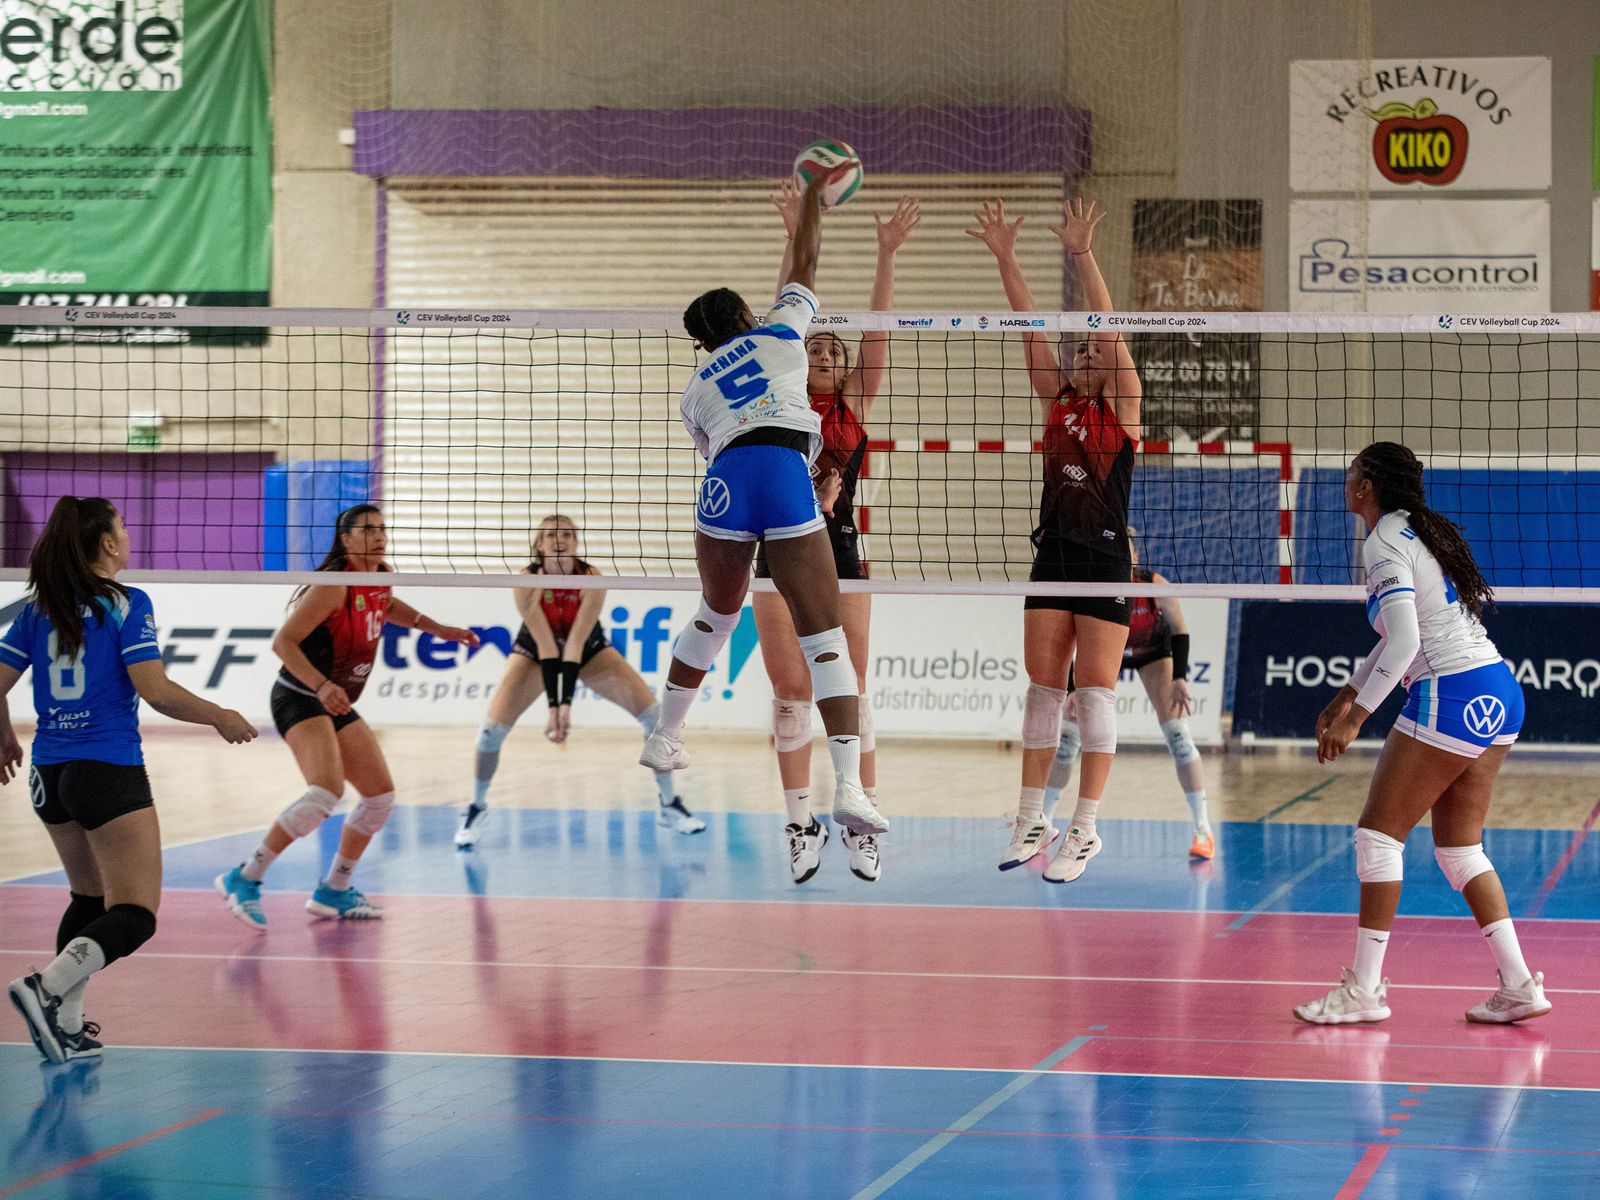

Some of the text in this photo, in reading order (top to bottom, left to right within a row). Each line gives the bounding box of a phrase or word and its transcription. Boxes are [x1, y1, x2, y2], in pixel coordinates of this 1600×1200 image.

[1326, 65, 1512, 125] RECREATIVOS
[0, 102, 88, 119] gmail.com
[1389, 131, 1451, 168] KIKO
[1311, 261, 1538, 284] Pesacontrol
[85, 311, 100, 319] CEV
[102, 311, 139, 320] Volleyball
[141, 312, 157, 321] Cup
[435, 314, 472, 323] Volleyball
[474, 314, 490, 323] Cup
[811, 316, 827, 325] Cup
[1000, 319, 1045, 327] HARIS.ES
[1108, 317, 1126, 325] CEV
[1127, 317, 1167, 327] Volleyball
[1168, 318, 1185, 327] Cup
[1460, 318, 1477, 326] CEV
[1479, 318, 1519, 327] Volleyball
[1521, 318, 1538, 327] Cup
[715, 358, 770, 410] 5
[47, 629, 86, 701] 8
[874, 650, 1018, 681] muebles
[378, 677, 496, 701] despier
[1504, 658, 1600, 698] ARQ
[873, 686, 993, 712] distribución
[999, 694, 1012, 718] y
[1463, 695, 1505, 738] VW
